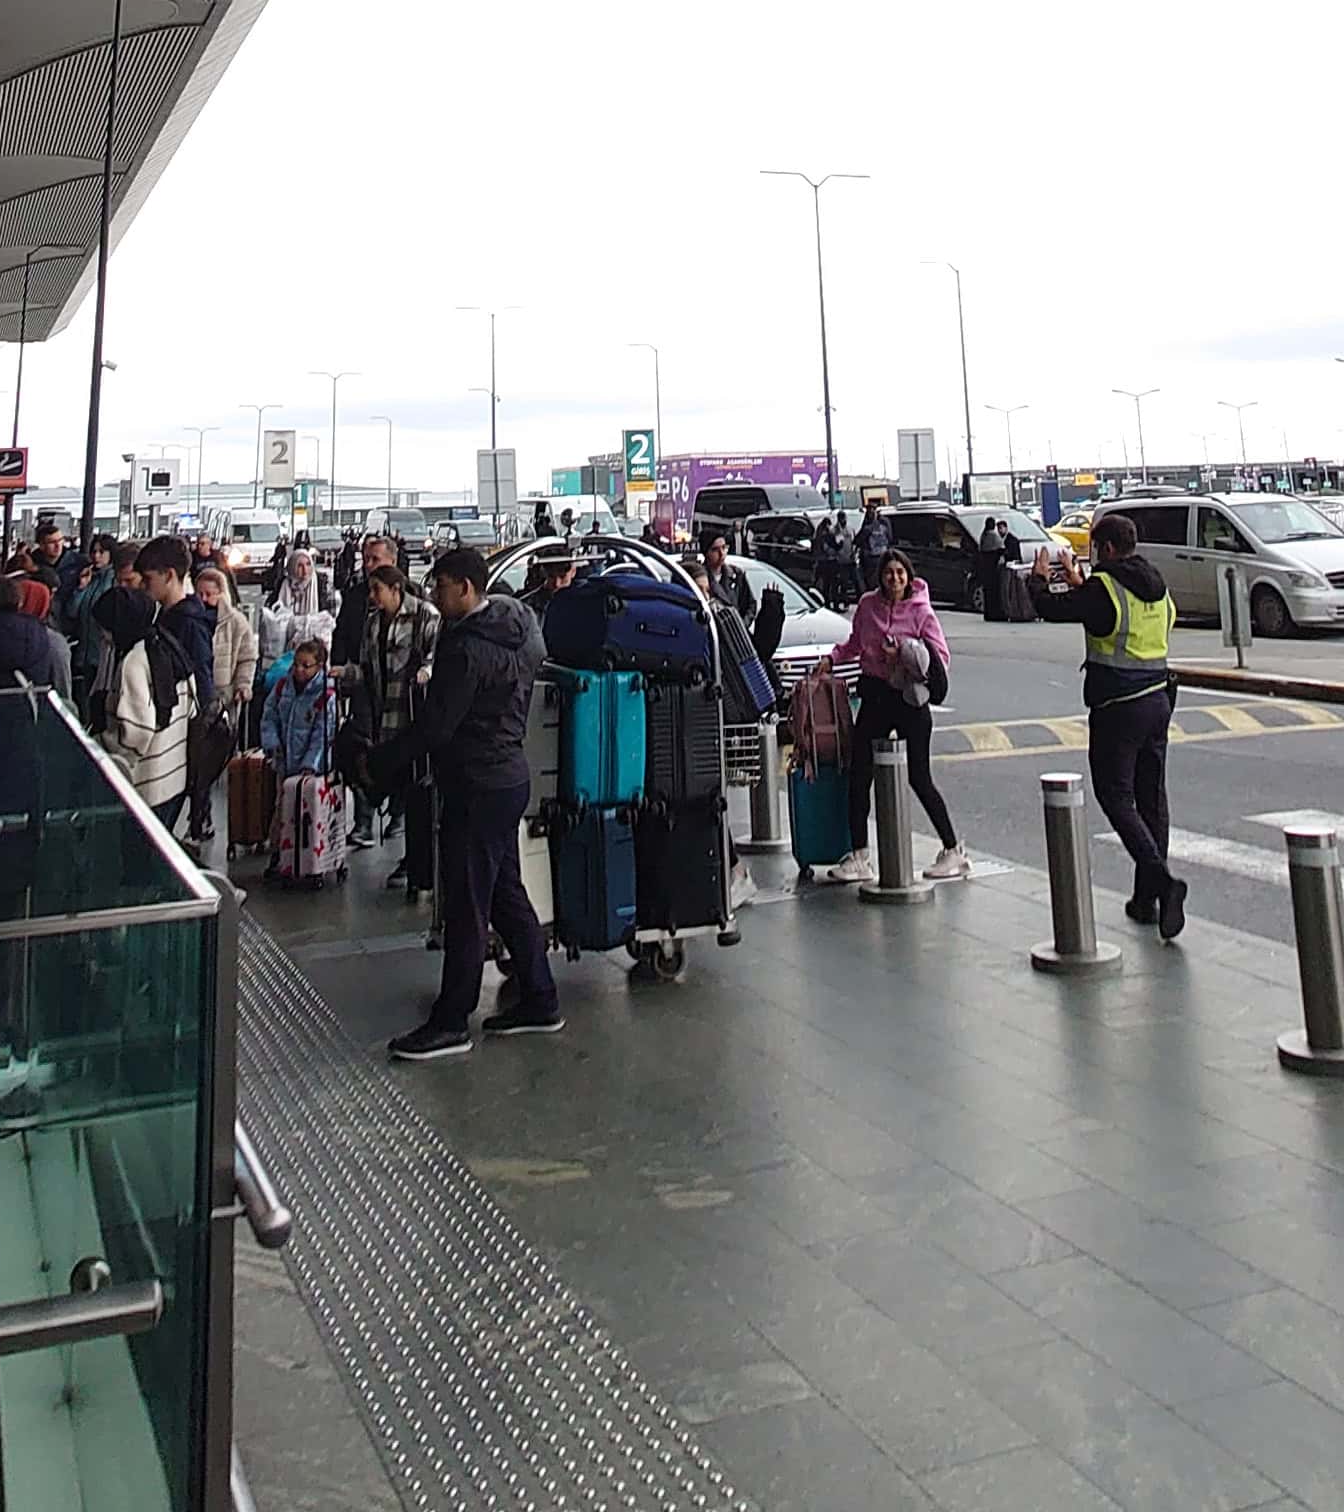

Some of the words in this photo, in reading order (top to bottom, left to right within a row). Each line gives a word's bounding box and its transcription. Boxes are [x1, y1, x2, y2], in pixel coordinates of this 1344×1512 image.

[271, 440, 289, 465] 2
[631, 433, 651, 465] 2
[671, 475, 690, 502] P6
